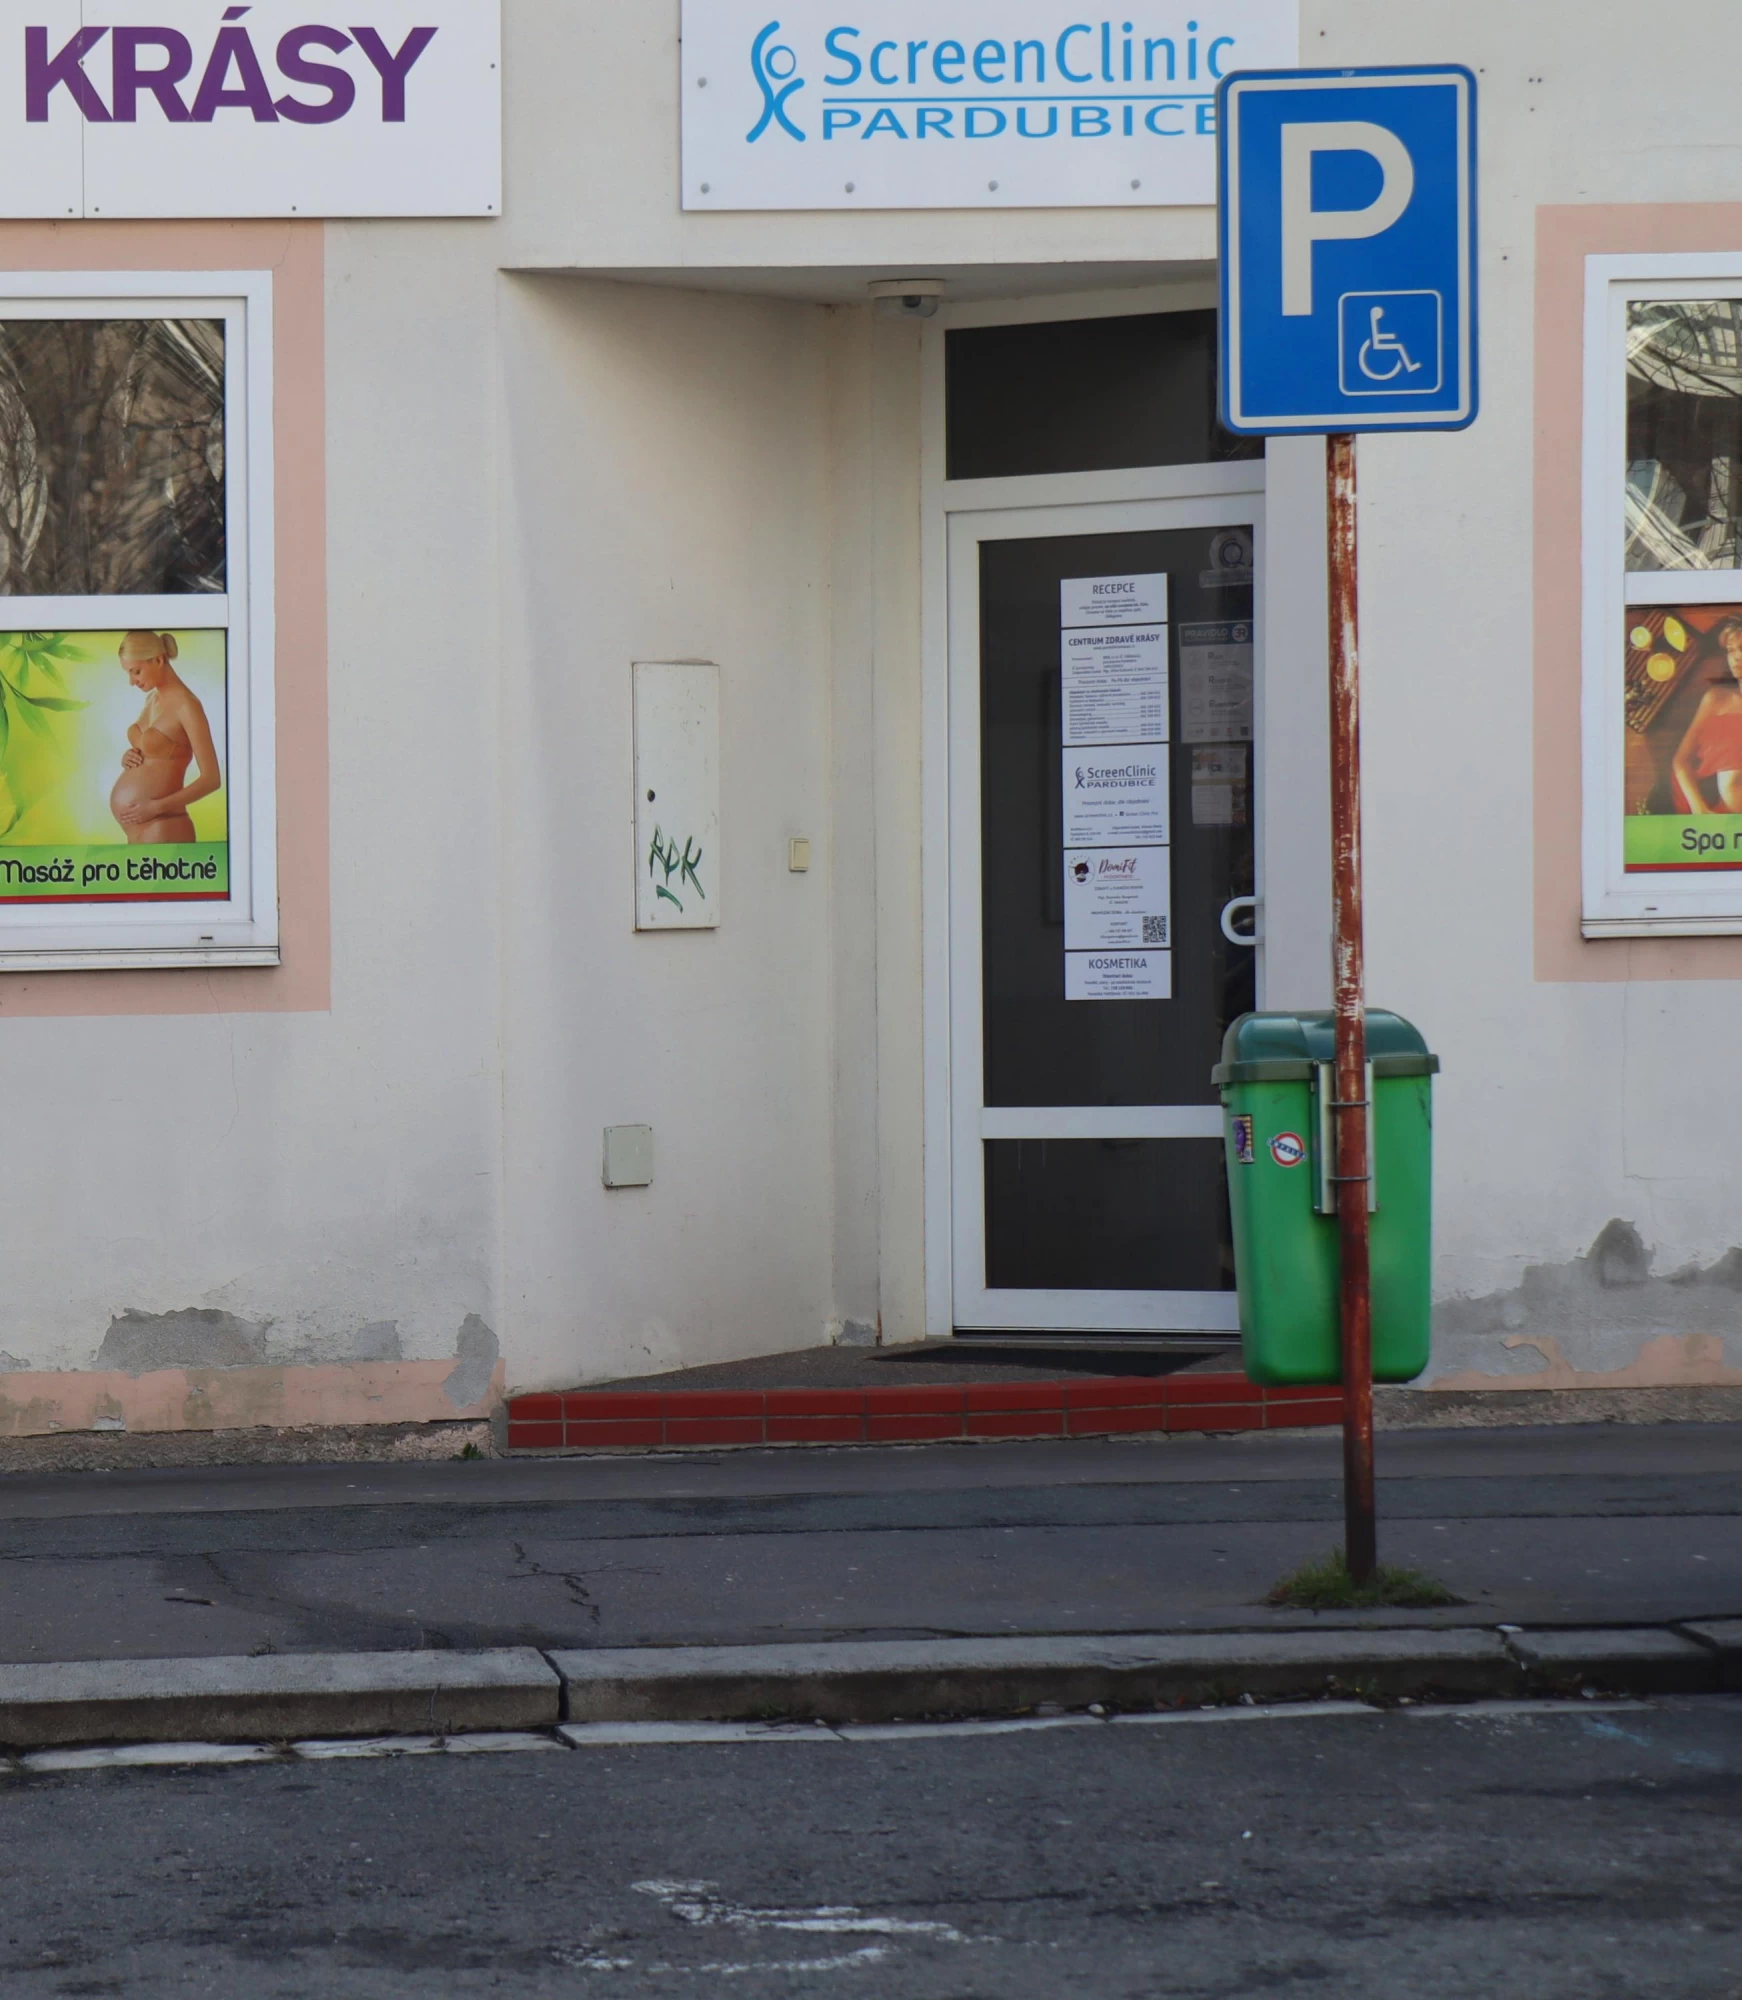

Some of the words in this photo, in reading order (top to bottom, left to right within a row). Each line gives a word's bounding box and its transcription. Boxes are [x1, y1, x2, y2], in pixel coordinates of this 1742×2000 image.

[823, 20, 1235, 87] ScreenClinic
[25, 6, 439, 124] KRÁSY
[822, 103, 1216, 141] PARDUBICE
[1281, 121, 1415, 317] P
[1093, 582, 1135, 594] RECEPCE
[1068, 637, 1104, 646] CENTRUM
[1106, 634, 1134, 644] ZDRAVÉ
[1136, 633, 1160, 642] KRÁSY
[1087, 765, 1156, 779] ScreenClinic
[1087, 779, 1156, 788] PARDUBICE
[1681, 828, 1725, 855] Spa
[82, 864, 120, 887] pro
[127, 855, 217, 881] těhotné
[1098, 858, 1137, 874] DomiFit
[1088, 958, 1148, 969] KOSMETIKA
